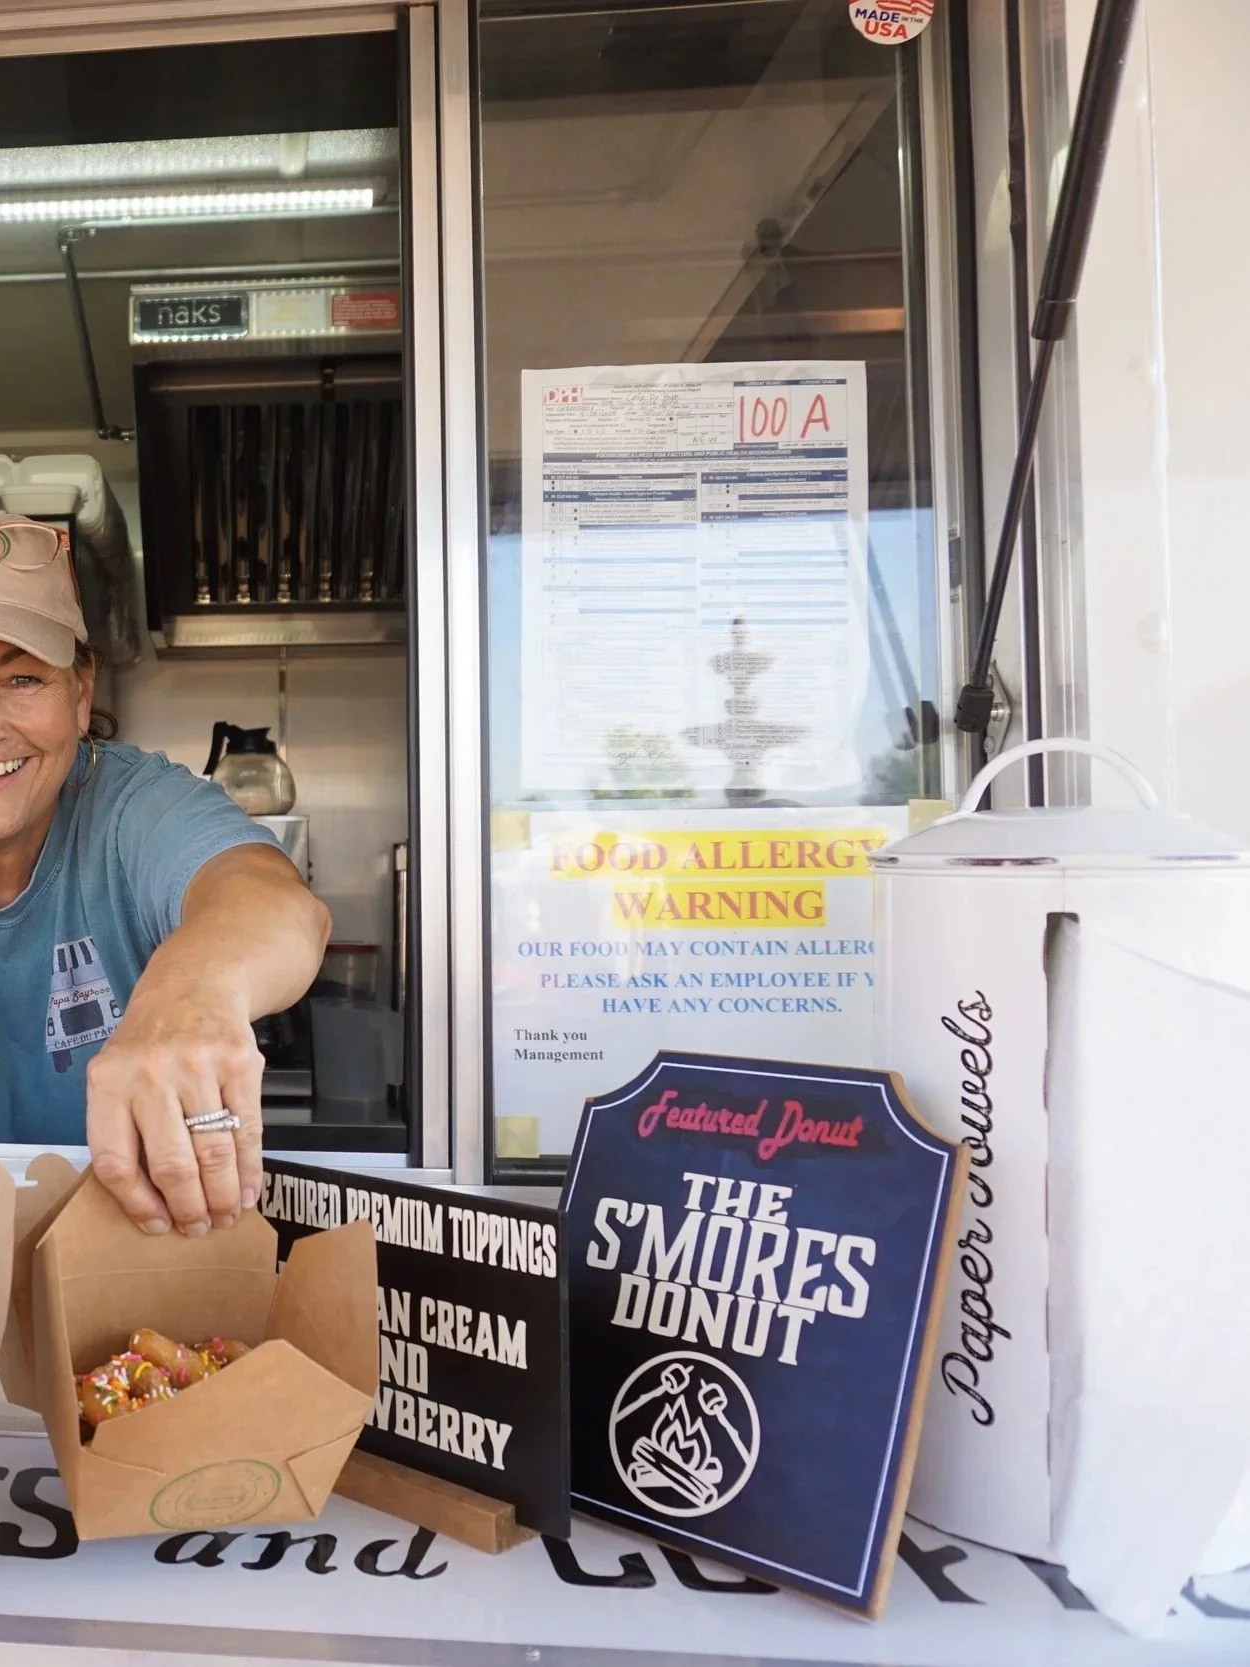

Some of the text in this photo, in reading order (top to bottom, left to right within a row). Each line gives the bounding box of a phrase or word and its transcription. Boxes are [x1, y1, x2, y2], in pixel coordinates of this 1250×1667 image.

[854, 8, 900, 23] MADE
[864, 20, 908, 39] USA
[740, 393, 830, 443] 100 A
[551, 842, 667, 872] FOOD
[614, 889, 824, 920] WARNING
[518, 941, 564, 958] OUR
[570, 941, 628, 958] FOOD
[636, 940, 684, 958] MAY
[690, 940, 788, 957] CONTAIN
[540, 972, 620, 989] PLEASE
[626, 972, 668, 988] ASK
[675, 972, 704, 988] AN
[710, 972, 831, 989] EMPLOYEE
[837, 972, 858, 987] IF
[602, 997, 842, 1014] HAVE ANY CONCERNS.
[80, 1032, 92, 1042] DU
[514, 1029, 588, 1043] Thank you
[514, 1048, 604, 1062] Management
[638, 1090, 864, 1160] Featured Donut
[682, 1172, 794, 1225] THE
[262, 1172, 557, 1278] EATURED PREMIUM TOPPINGS
[585, 1196, 877, 1320] S'MORES
[420, 1296, 528, 1370] CREAM
[610, 1272, 818, 1366] DONUT
[941, 1218, 1012, 1427] Paper
[380, 1335, 428, 1394] ND
[153, 1526, 448, 1580] and
